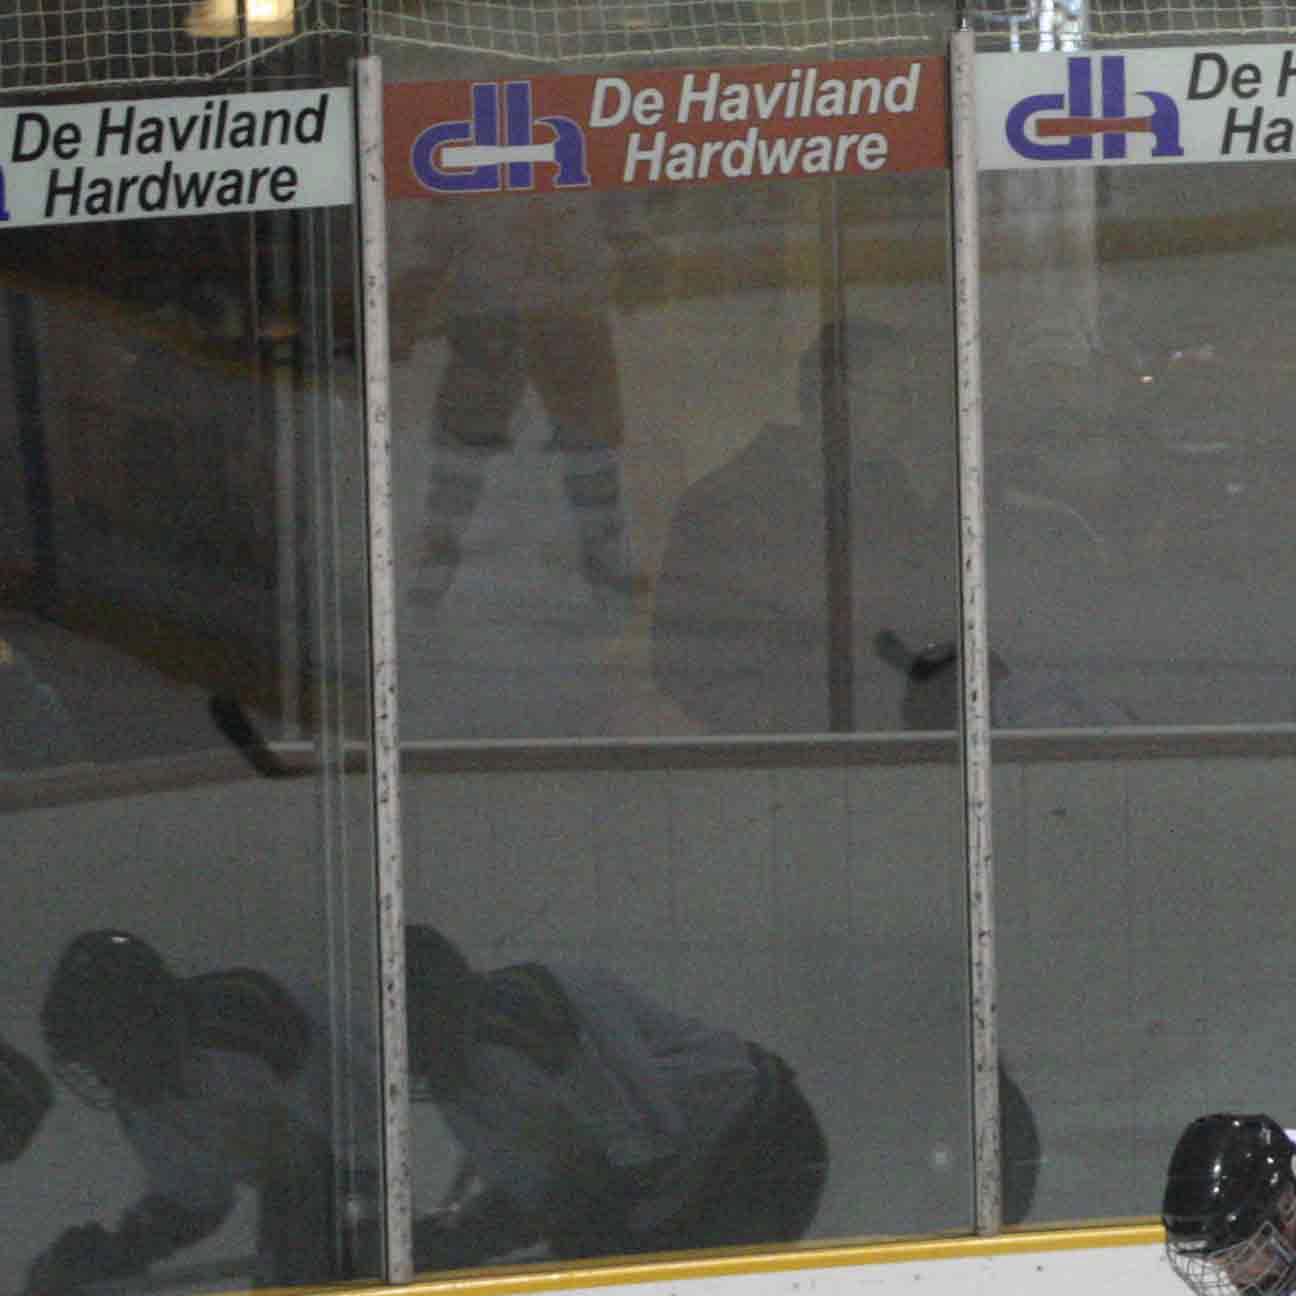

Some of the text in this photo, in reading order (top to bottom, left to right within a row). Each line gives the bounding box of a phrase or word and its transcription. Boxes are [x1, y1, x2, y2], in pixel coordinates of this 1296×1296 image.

[589, 63, 922, 129] De Haviland
[1187, 51, 1262, 101] De
[12, 93, 330, 163] De Haviland
[622, 127, 890, 184] Hardware
[44, 160, 299, 219] Hardware
